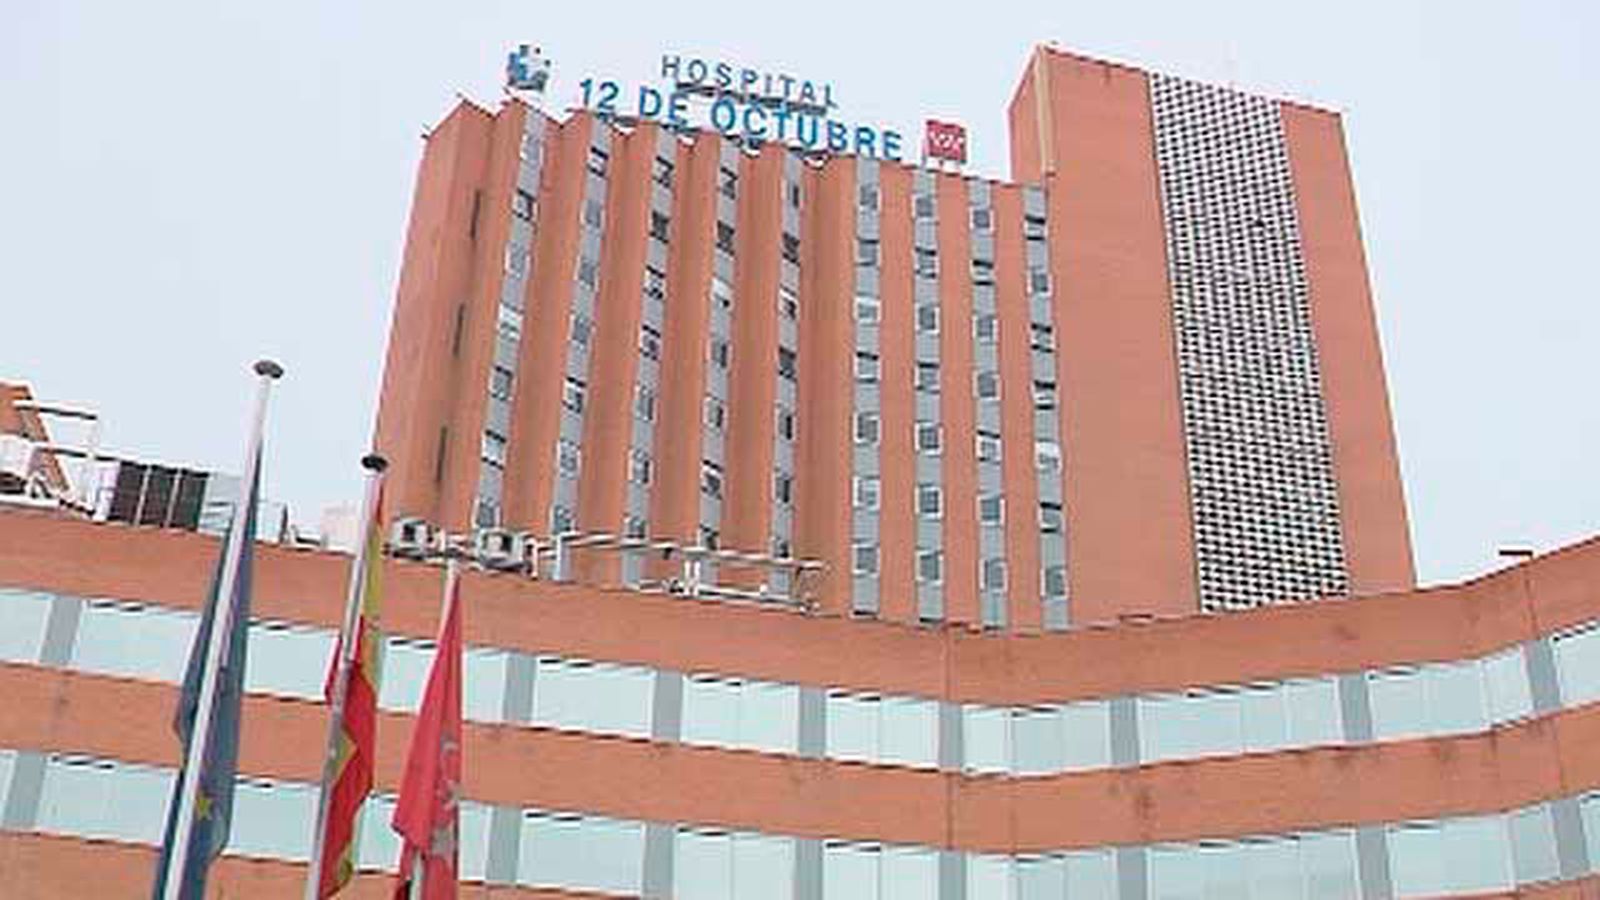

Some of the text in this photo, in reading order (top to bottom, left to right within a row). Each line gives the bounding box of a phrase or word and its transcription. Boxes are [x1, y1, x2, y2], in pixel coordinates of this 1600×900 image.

[661, 55, 838, 108] HOSPITAL
[579, 78, 904, 162] 12 DE OCTUBRE
